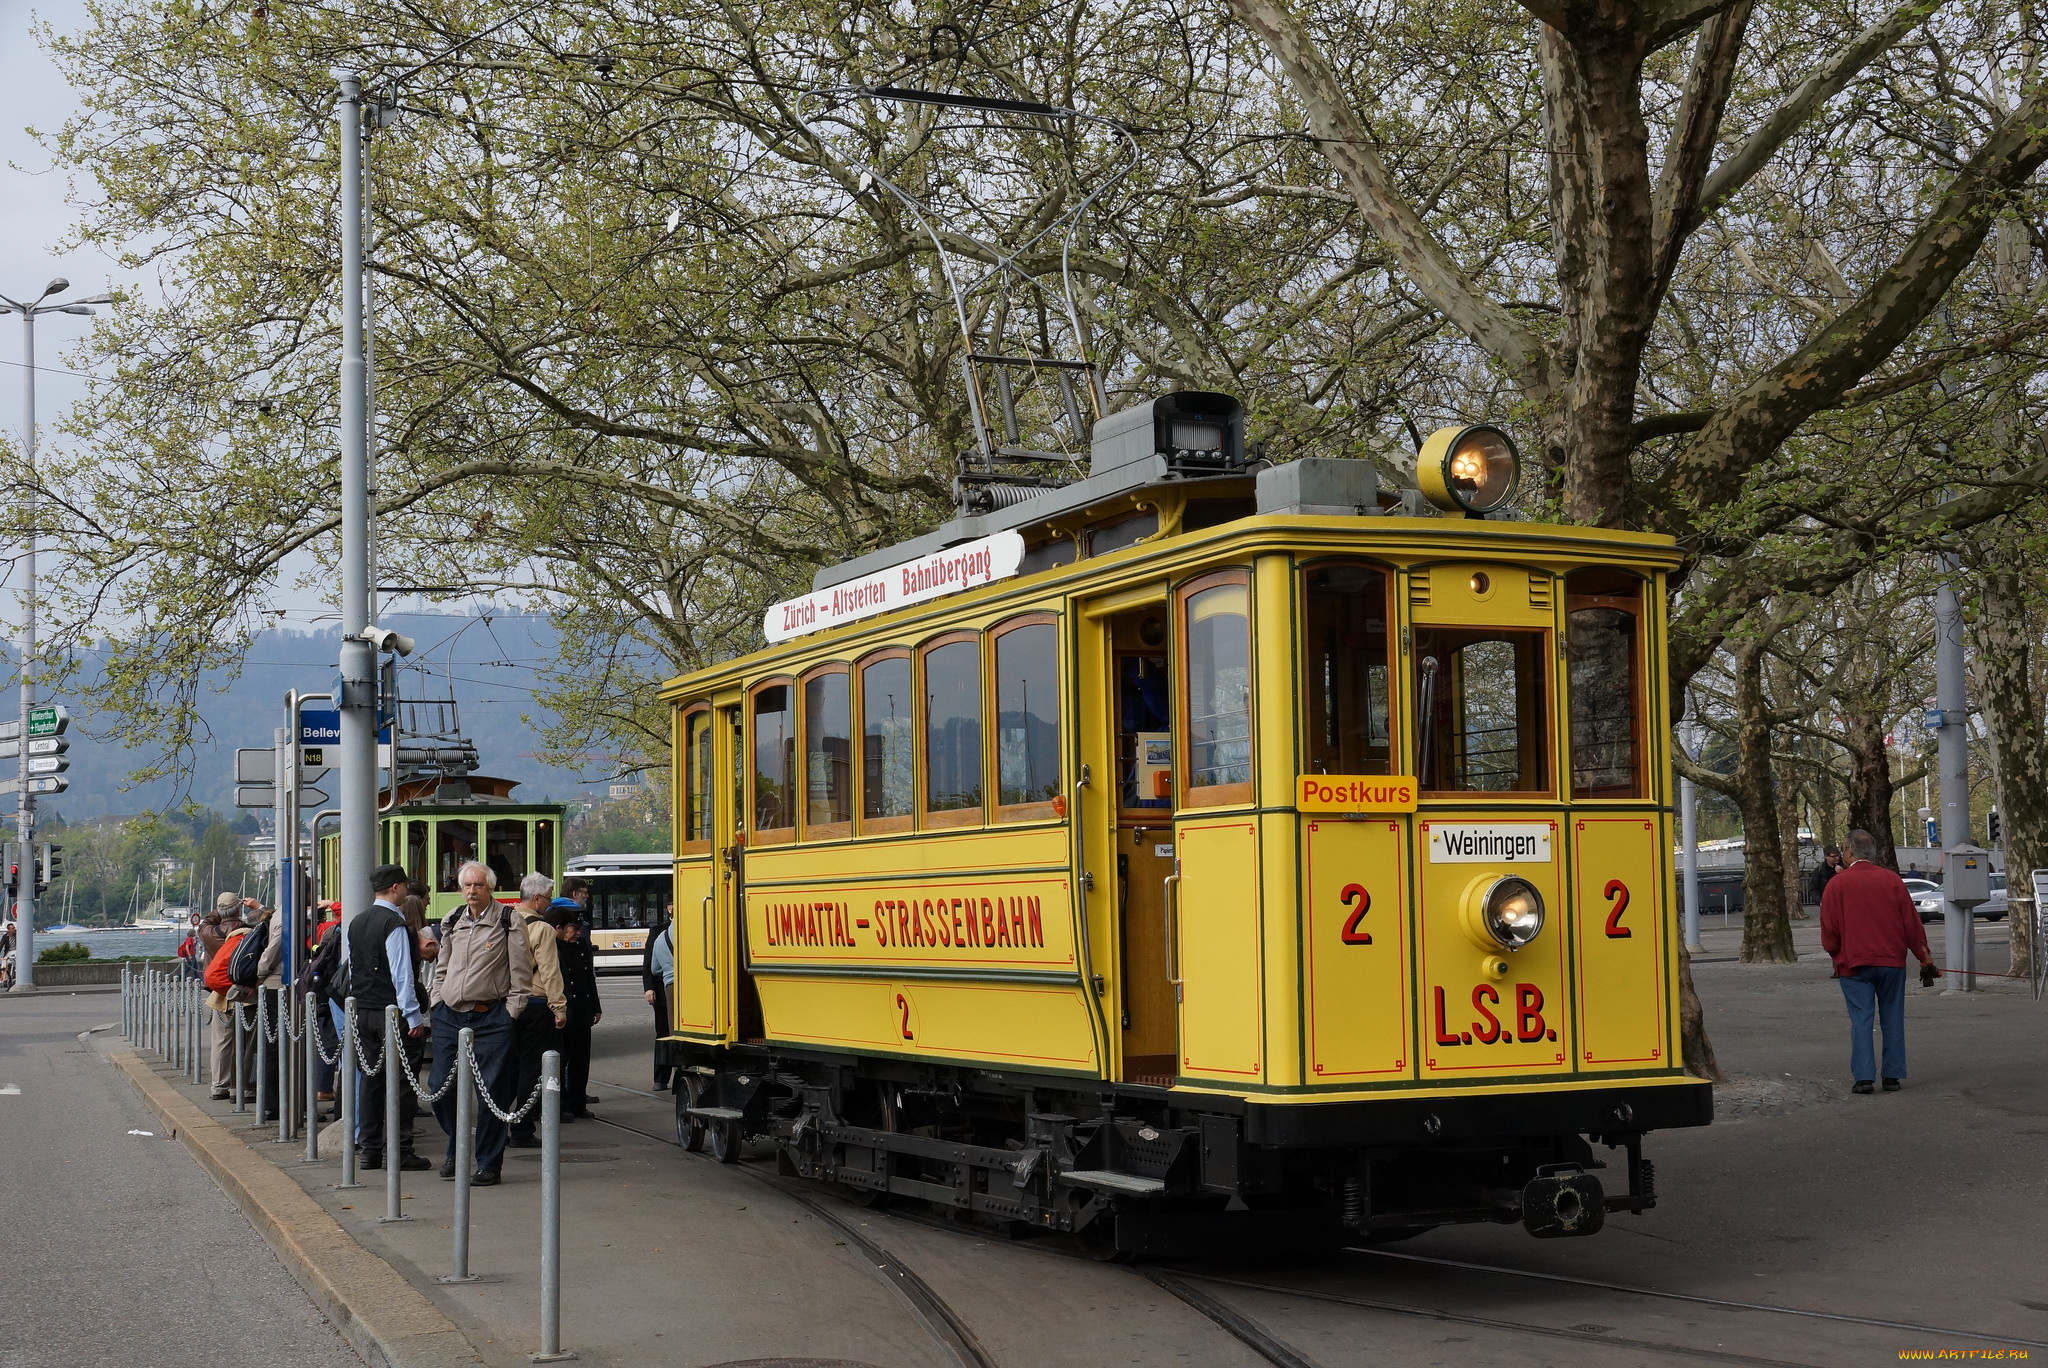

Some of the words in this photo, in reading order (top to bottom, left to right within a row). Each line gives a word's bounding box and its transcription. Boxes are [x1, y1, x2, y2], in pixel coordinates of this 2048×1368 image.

[784, 599, 816, 631] Zürich
[832, 580, 886, 617] Altstetten
[902, 545, 991, 596] Bahnübergang
[31, 711, 54, 721] Winterthur
[34, 721, 56, 733] Flughafen
[35, 741, 50, 750] Central
[303, 727, 341, 738] Bellev
[305, 754, 322, 762] N18
[1303, 780, 1411, 803] Postkurs
[1443, 830, 1536, 860] Weiningen
[1340, 883, 1372, 945] 2
[1603, 879, 1632, 938] 2
[896, 993, 913, 1040] 2
[1434, 983, 1557, 1046] L.S.B.
